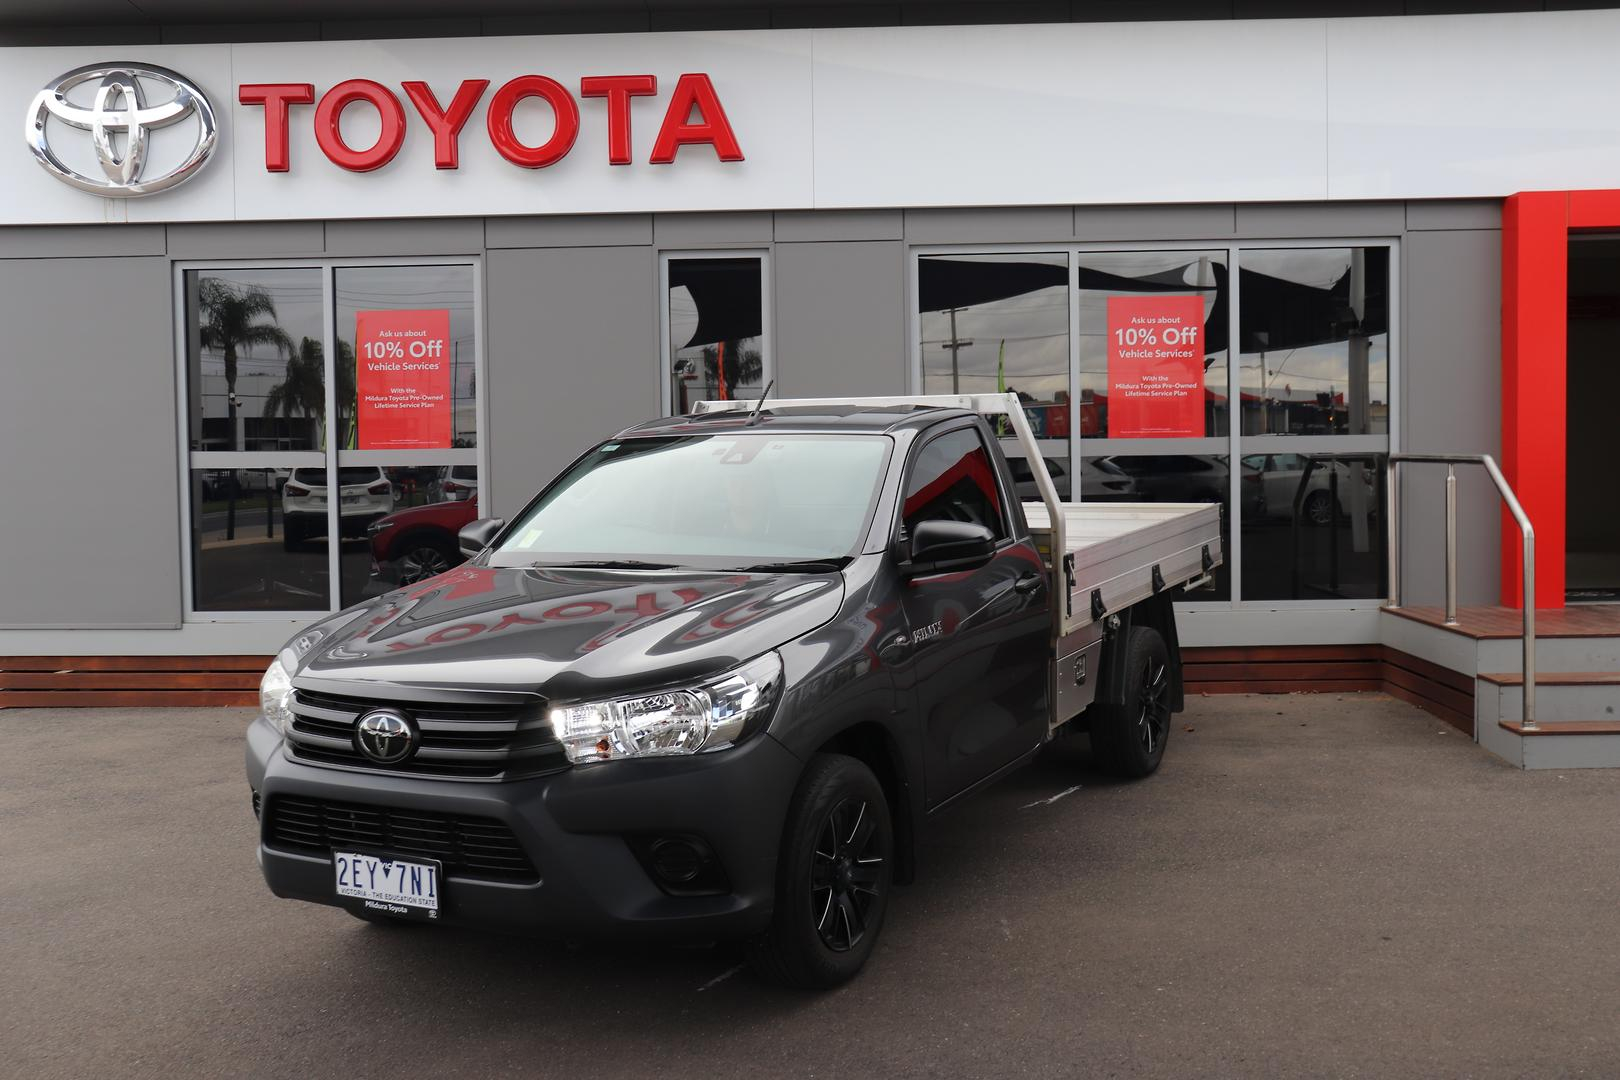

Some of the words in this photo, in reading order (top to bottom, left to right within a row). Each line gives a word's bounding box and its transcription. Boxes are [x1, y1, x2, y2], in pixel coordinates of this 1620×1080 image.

[239, 73, 746, 173] TOYOTA
[1131, 316, 1146, 324] Ask
[1157, 316, 1181, 324] about
[1115, 327, 1157, 346] 10%
[1162, 326, 1198, 345] Off
[364, 341, 404, 359] 10%
[409, 339, 443, 358] Off
[1119, 349, 1153, 359] Vehicle
[367, 362, 401, 371] Vehicle
[337, 857, 377, 890] 2EY
[396, 864, 435, 897] 7NI
[341, 887, 366, 897] VICTORIA
[372, 891, 384, 899] THE
[385, 893, 417, 904] EDUCATION
[418, 898, 436, 907] STATE
[365, 900, 388, 910] Mildura
[388, 904, 408, 914] Toyota
